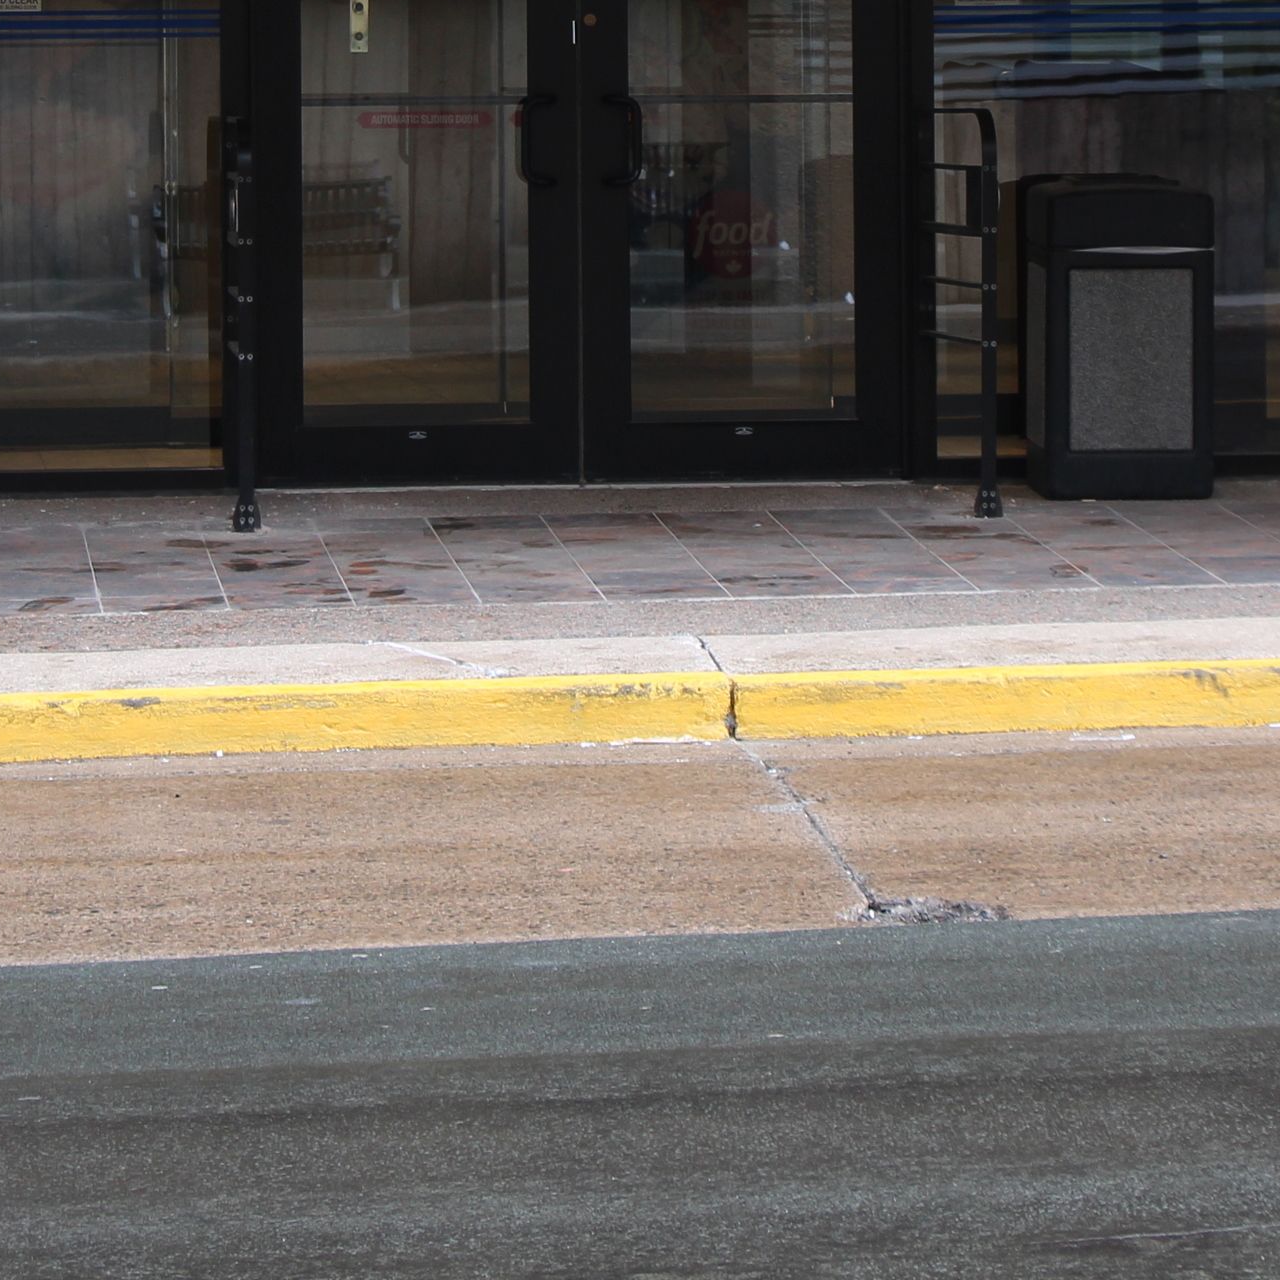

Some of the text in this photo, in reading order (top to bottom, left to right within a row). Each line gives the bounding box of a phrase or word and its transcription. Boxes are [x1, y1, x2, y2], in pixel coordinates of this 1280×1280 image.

[370, 113, 479, 125] AUTOMATIC SLIDING DOOR
[692, 209, 774, 260] food
